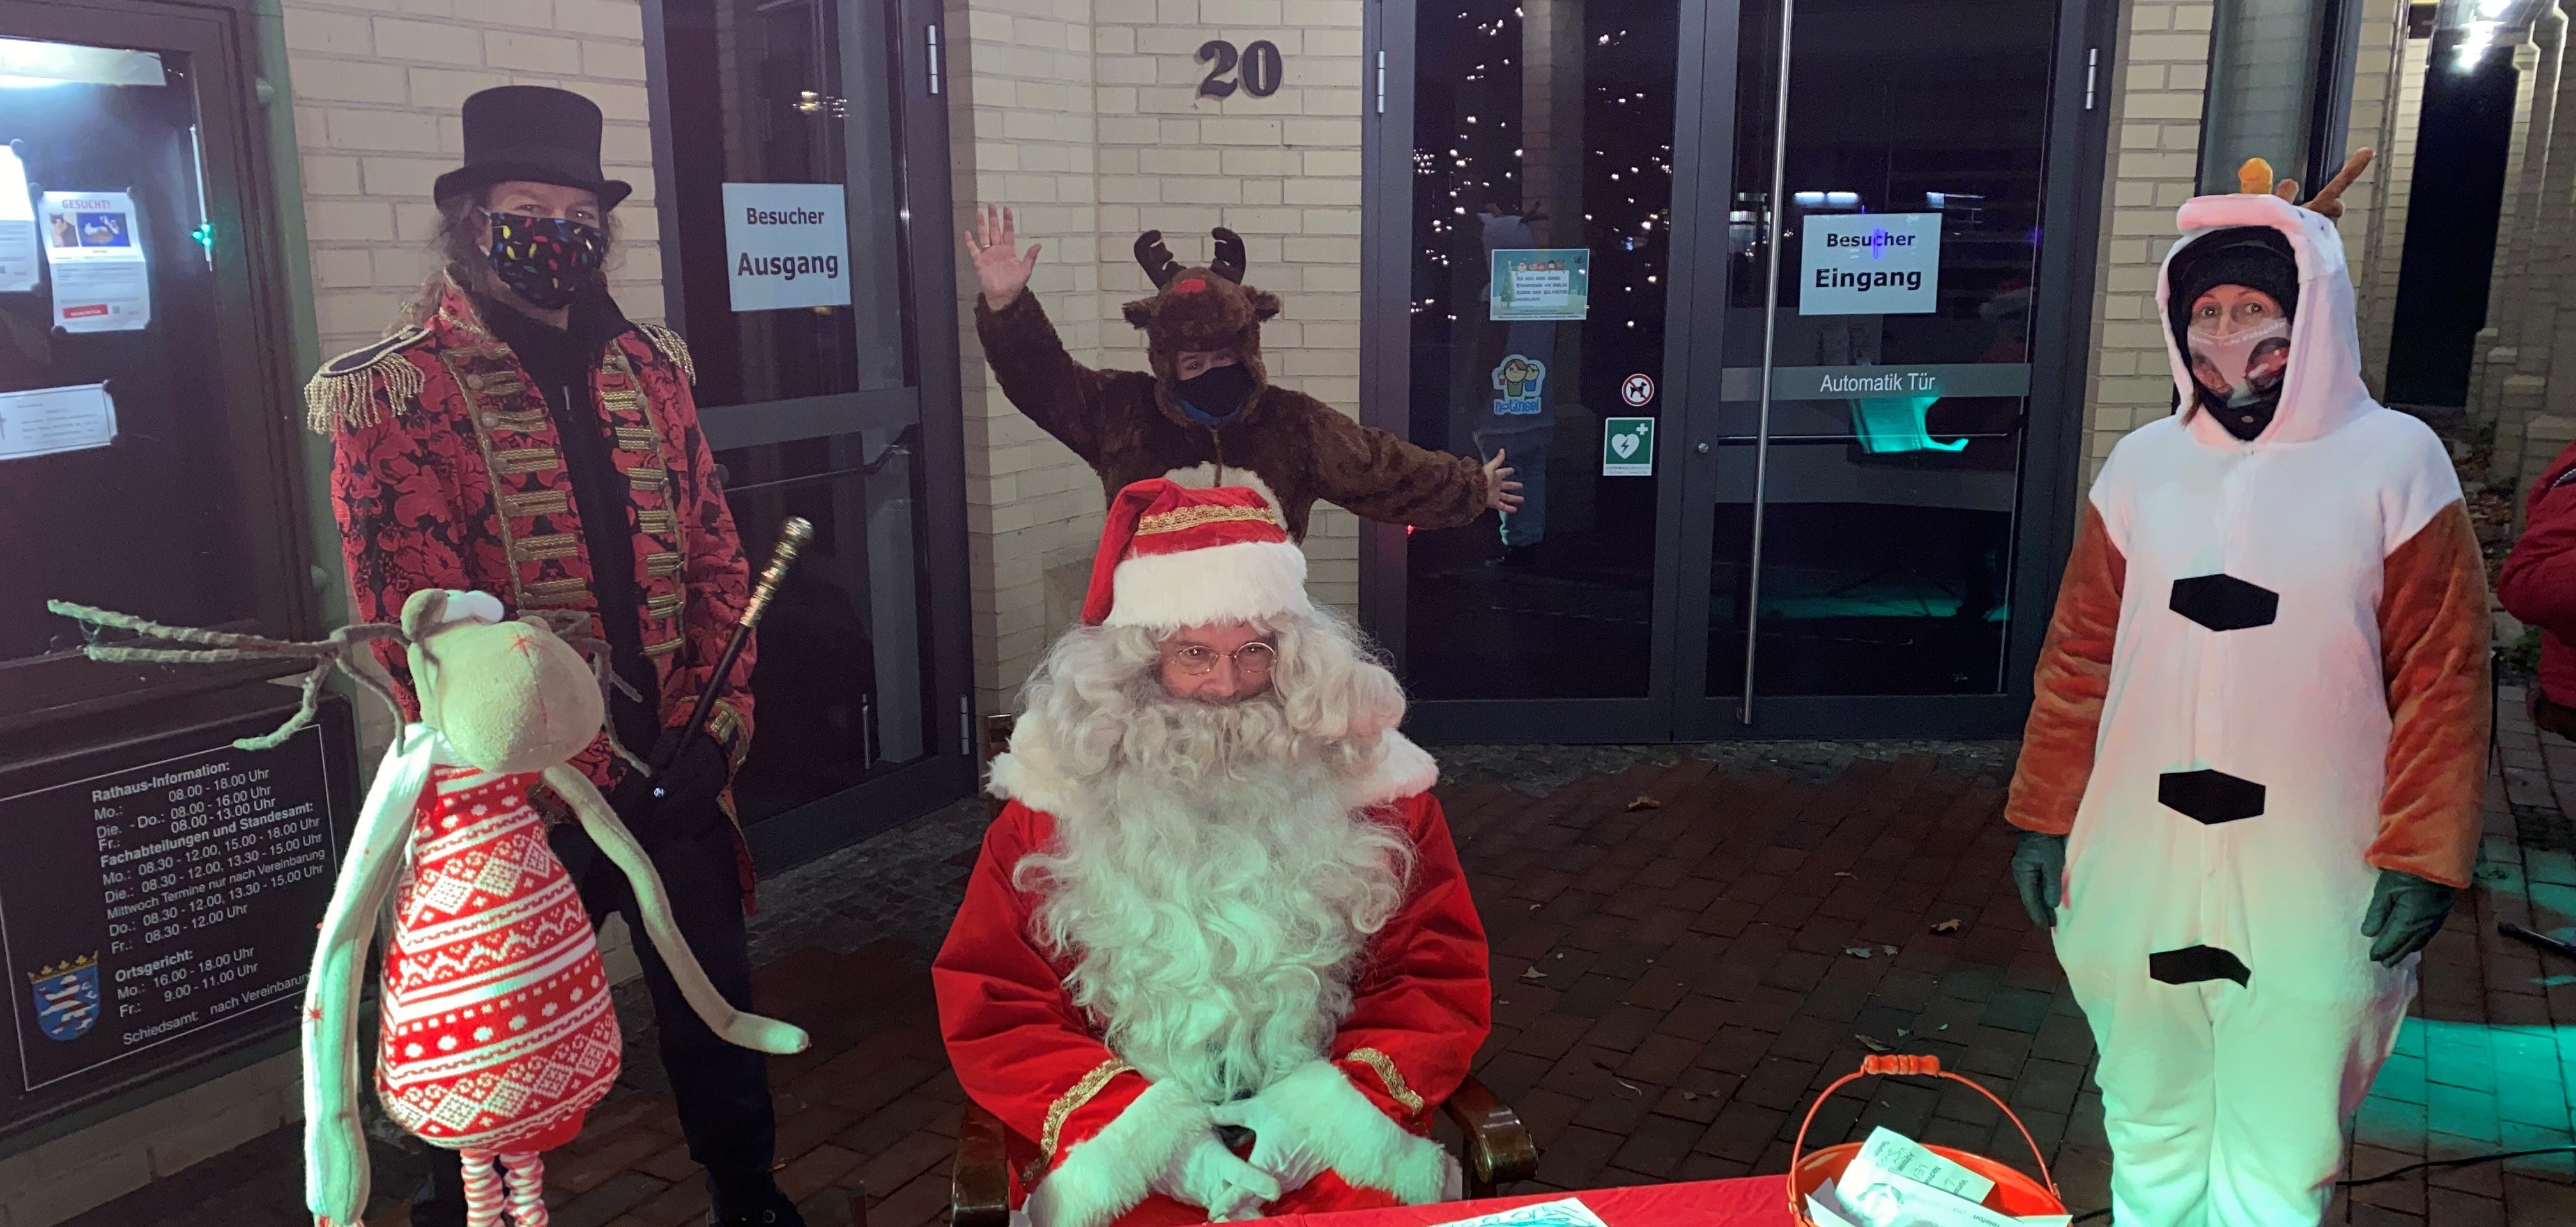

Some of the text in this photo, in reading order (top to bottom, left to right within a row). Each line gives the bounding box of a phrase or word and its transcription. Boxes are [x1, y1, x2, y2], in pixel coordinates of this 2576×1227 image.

[1198, 40, 1282, 98] 20
[61, 199, 111, 209] GESUCHT!
[746, 207, 824, 225] Besucher
[1827, 232, 1915, 247] Besucher
[737, 252, 838, 281] Ausgang
[1816, 268, 1922, 291] Eingang
[1820, 373, 1936, 392] Automatik Tür
[92, 762, 230, 803] Rathaus-Information:
[169, 784, 203, 802] 08.00
[213, 773, 245, 791] 18.00
[249, 769, 270, 782] Uhr
[171, 801, 204, 819] 08.00
[216, 791, 247, 807] 16.00
[250, 786, 271, 799] Uhr
[171, 814, 207, 833] 08.00
[217, 803, 250, 821] 13.00
[254, 798, 276, 811] Uhr
[100, 801, 314, 868] Fachabteilungen und Standesamt:
[139, 857, 173, 876] 08.30
[225, 833, 256, 851] 15.00
[267, 822, 297, 840] 18.00
[300, 818, 320, 830] Uhr
[142, 874, 176, 893] 08.30
[227, 850, 259, 867] 13.30
[270, 838, 300, 856] 15.00
[303, 833, 322, 846] Uhr
[107, 849, 325, 920] Mittwoch Termine nur nach Vereinbarung
[143, 907, 178, 926] 08.30
[229, 882, 260, 900] 13.30
[271, 870, 301, 888] 15.00
[303, 865, 323, 877] Uhr
[145, 923, 180, 943] 08.30
[192, 911, 224, 929] 12.00
[226, 904, 248, 918] Uhr
[115, 950, 193, 982] Ortsgericht:
[153, 968, 187, 987] 16.00
[198, 954, 230, 973] 18.00
[233, 947, 254, 961] Uhr
[164, 984, 190, 1002] 9.00
[202, 970, 234, 989] 11.00
[237, 963, 257, 977] Uhr
[123, 973, 310, 1045] Schiedsamt: nach Vereinbarun
[1926, 1166, 1942, 1185] Nachna
[1953, 1179, 1968, 1195] Vorna
